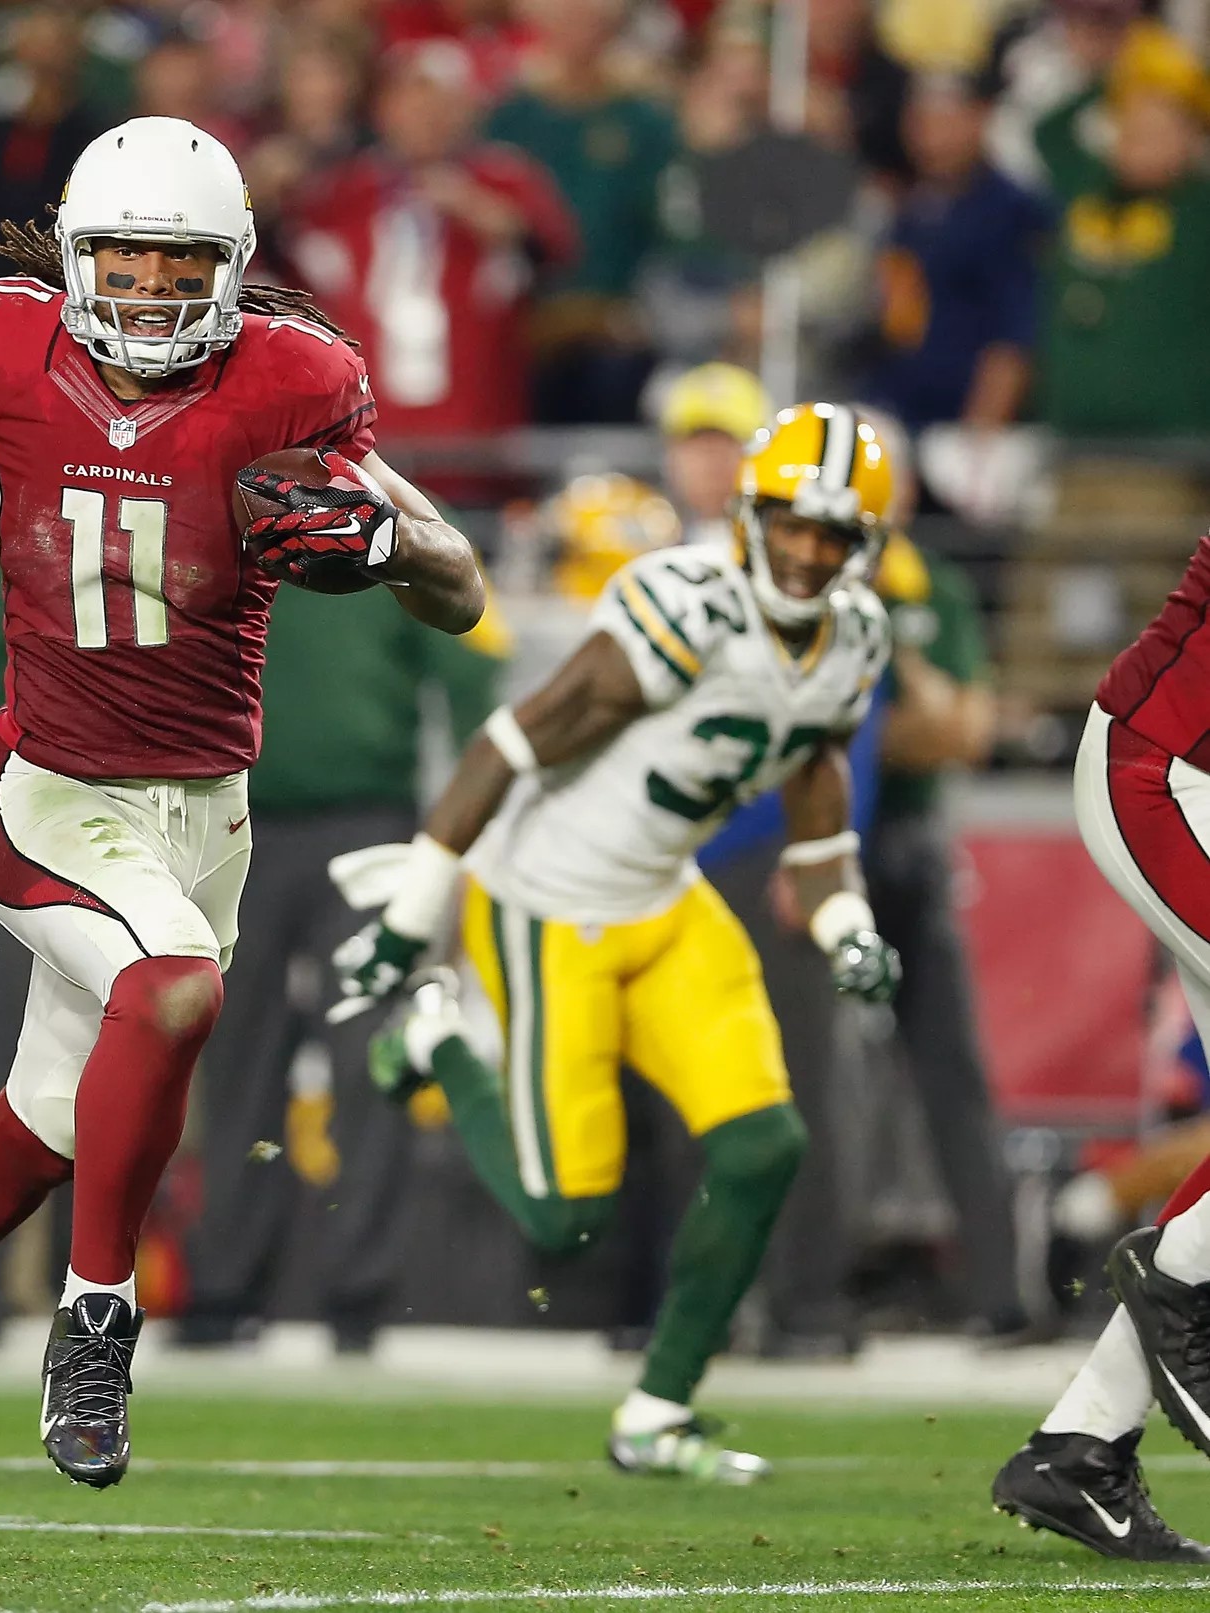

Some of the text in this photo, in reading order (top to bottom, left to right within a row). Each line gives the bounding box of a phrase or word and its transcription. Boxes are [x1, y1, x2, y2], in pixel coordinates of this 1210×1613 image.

[134, 215, 171, 223] CARDINALS
[62, 463, 174, 487] CARDINALS
[61, 484, 170, 650] 11
